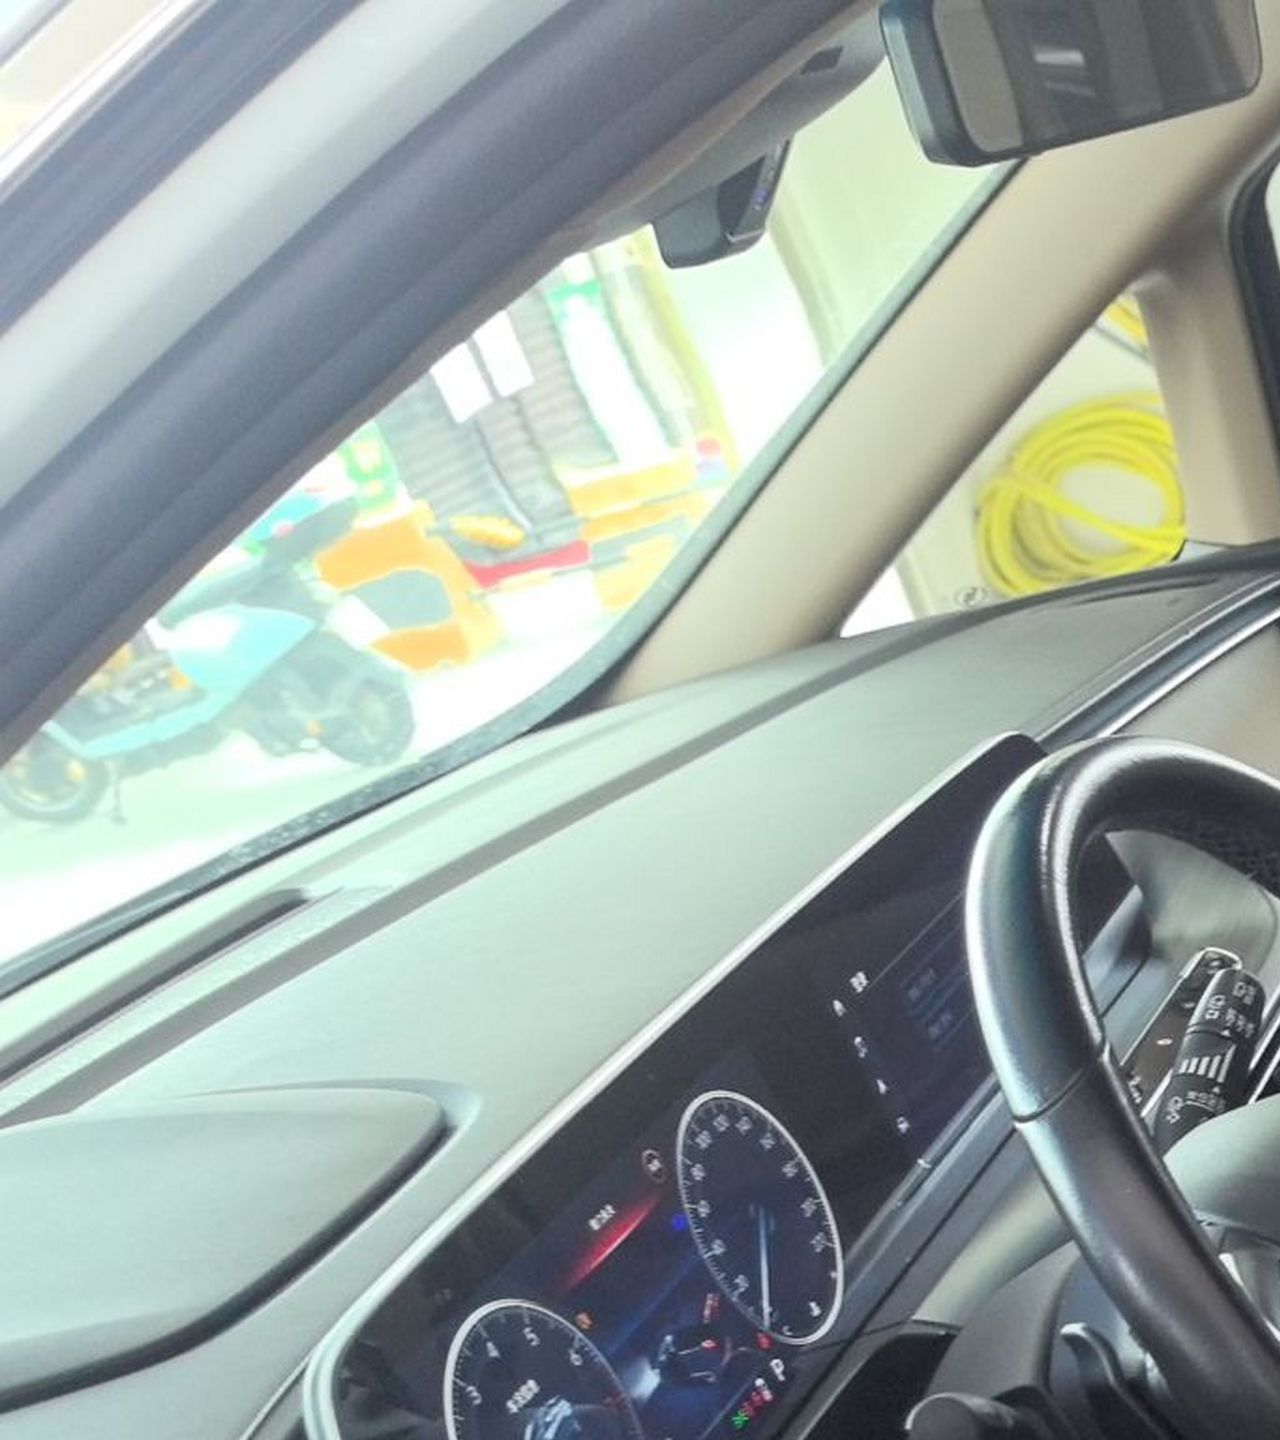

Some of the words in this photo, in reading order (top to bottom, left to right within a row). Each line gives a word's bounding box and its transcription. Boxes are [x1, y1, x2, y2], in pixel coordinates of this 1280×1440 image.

[523, 1326, 540, 1346] 5
[569, 1348, 583, 1366] 6
[769, 1358, 785, 1381] P
[466, 1385, 482, 1404] 3
